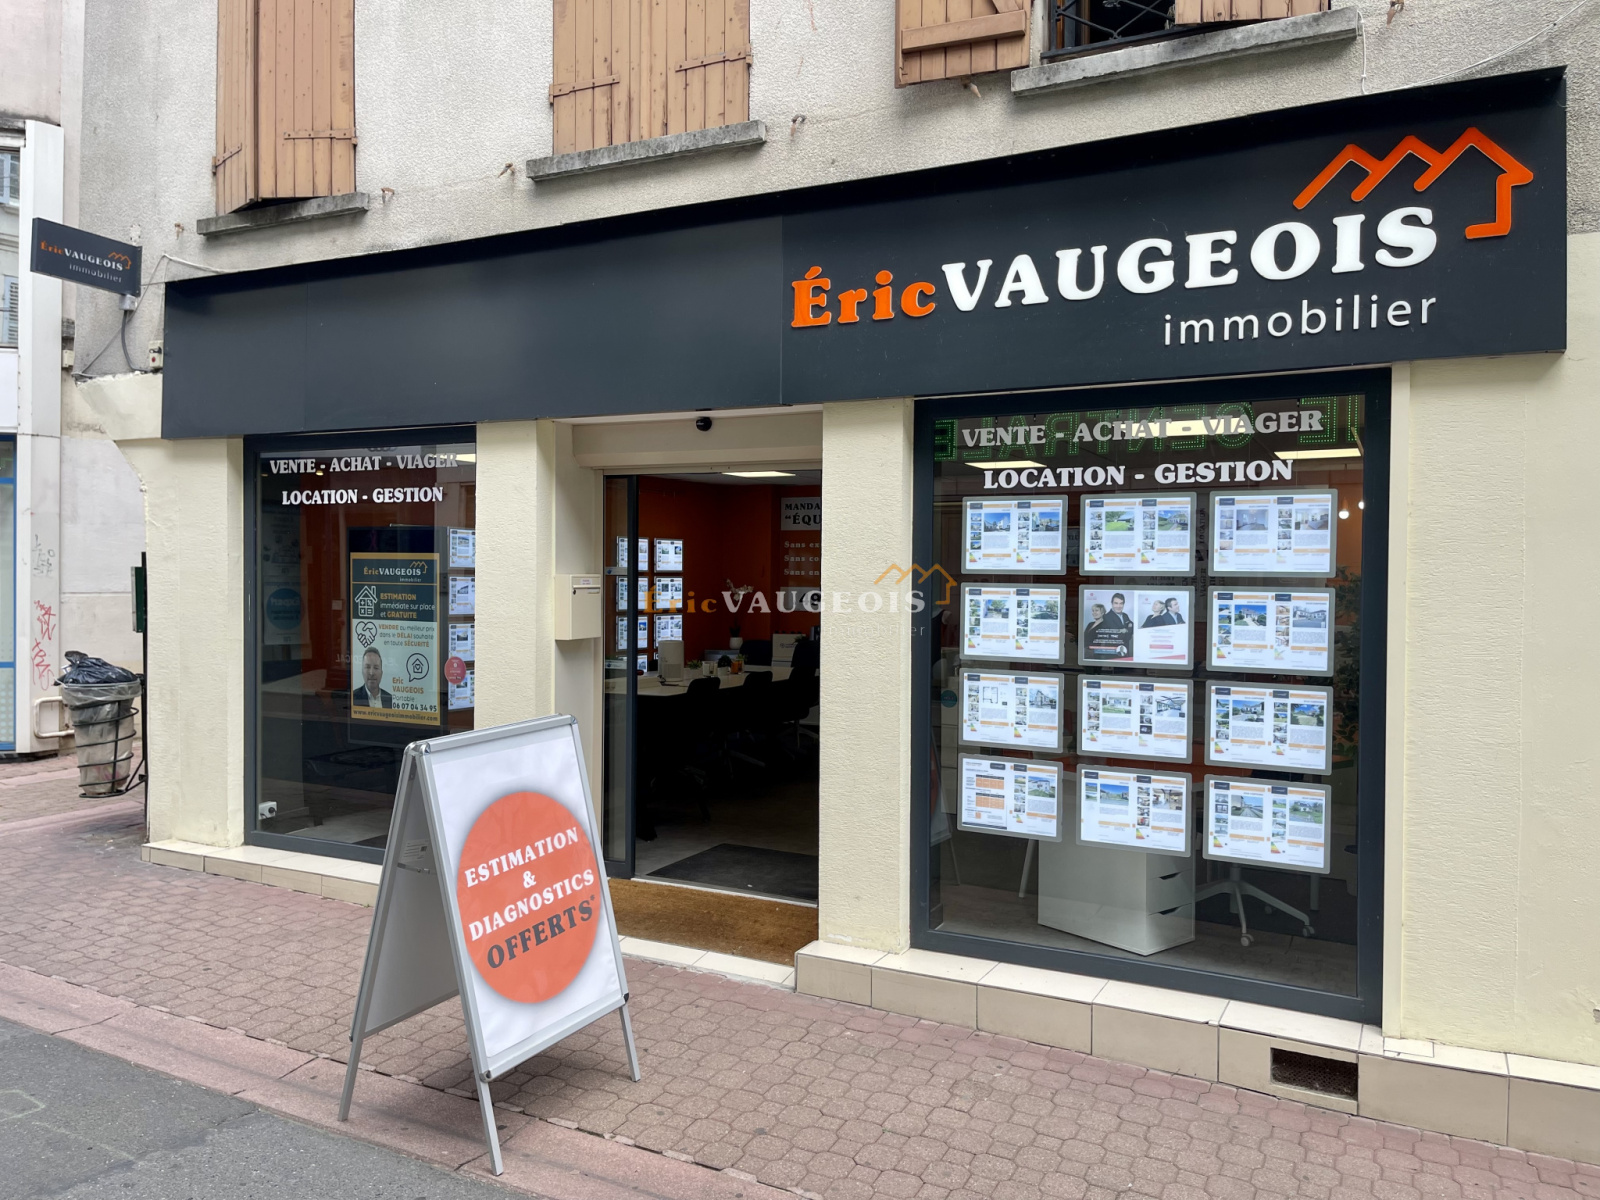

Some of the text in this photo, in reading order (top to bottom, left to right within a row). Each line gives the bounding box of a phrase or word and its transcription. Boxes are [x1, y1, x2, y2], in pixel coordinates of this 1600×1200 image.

[40, 240, 124, 271] Éric VAUGEOIS
[69, 263, 122, 283] immobilier
[790, 206, 1437, 328] Éric VAUGEOIS
[1164, 294, 1437, 345] immobilier
[961, 424, 1046, 448] VENTE
[1072, 418, 1172, 443] ACHAT
[1201, 409, 1324, 436] VIAGER
[270, 458, 316, 474] VENTE
[329, 455, 382, 472] ACHAT
[396, 452, 459, 469] VIAGER
[983, 464, 1127, 490] LOCATION
[1154, 459, 1294, 484] GESTION
[282, 489, 358, 505] LOCATION
[372, 486, 444, 503] GESTION
[784, 540, 806, 548] Sans
[784, 554, 805, 562] Sans
[363, 566, 421, 576] Éric VAUGEOIS
[784, 568, 805, 576] Sans
[380, 592, 417, 601] ESTIMATION
[380, 601, 409, 610] immédiate
[419, 603, 436, 611] place
[387, 611, 417, 619] GRATUITE
[397, 631, 412, 639] DÉLAI
[392, 676, 404, 684] Eric
[392, 685, 424, 694] VAUGEOIS
[464, 826, 579, 888] ESTIMATION
[522, 870, 537, 889] &
[468, 868, 595, 942] DIAGNOSTICS
